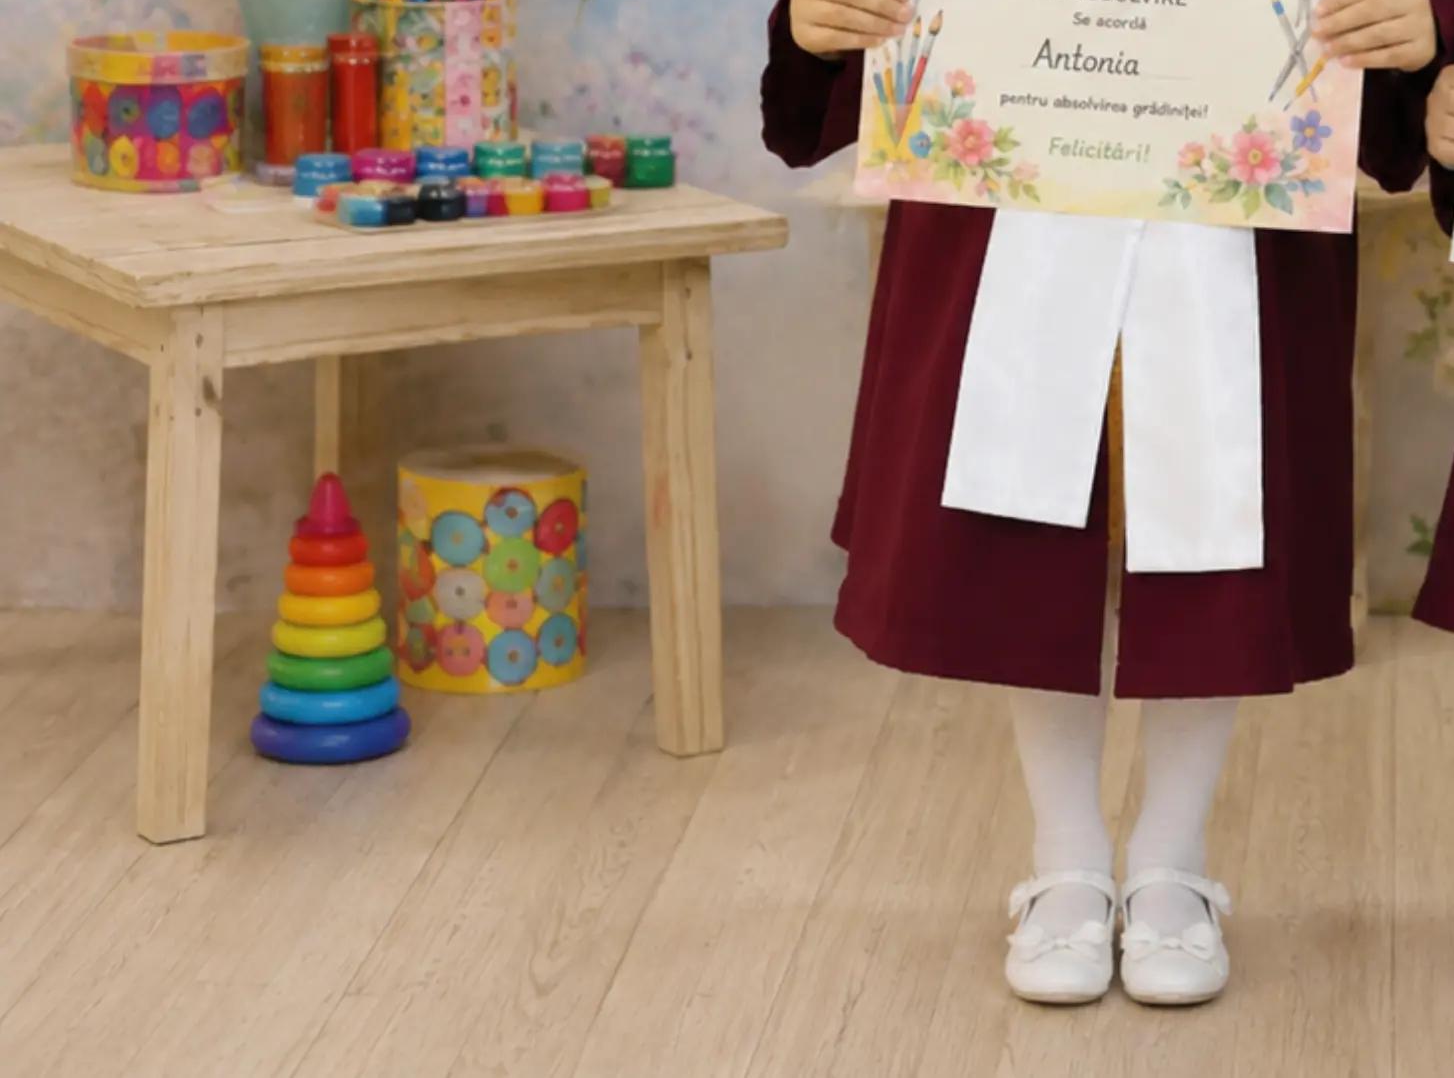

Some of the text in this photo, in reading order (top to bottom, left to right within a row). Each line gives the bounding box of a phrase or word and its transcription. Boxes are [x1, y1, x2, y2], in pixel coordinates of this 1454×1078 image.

[1072, 11, 1147, 31] Se acordă
[1032, 37, 1140, 76] Antonia
[999, 93, 1048, 107] pentru
[1053, 95, 1128, 114] absolvirea
